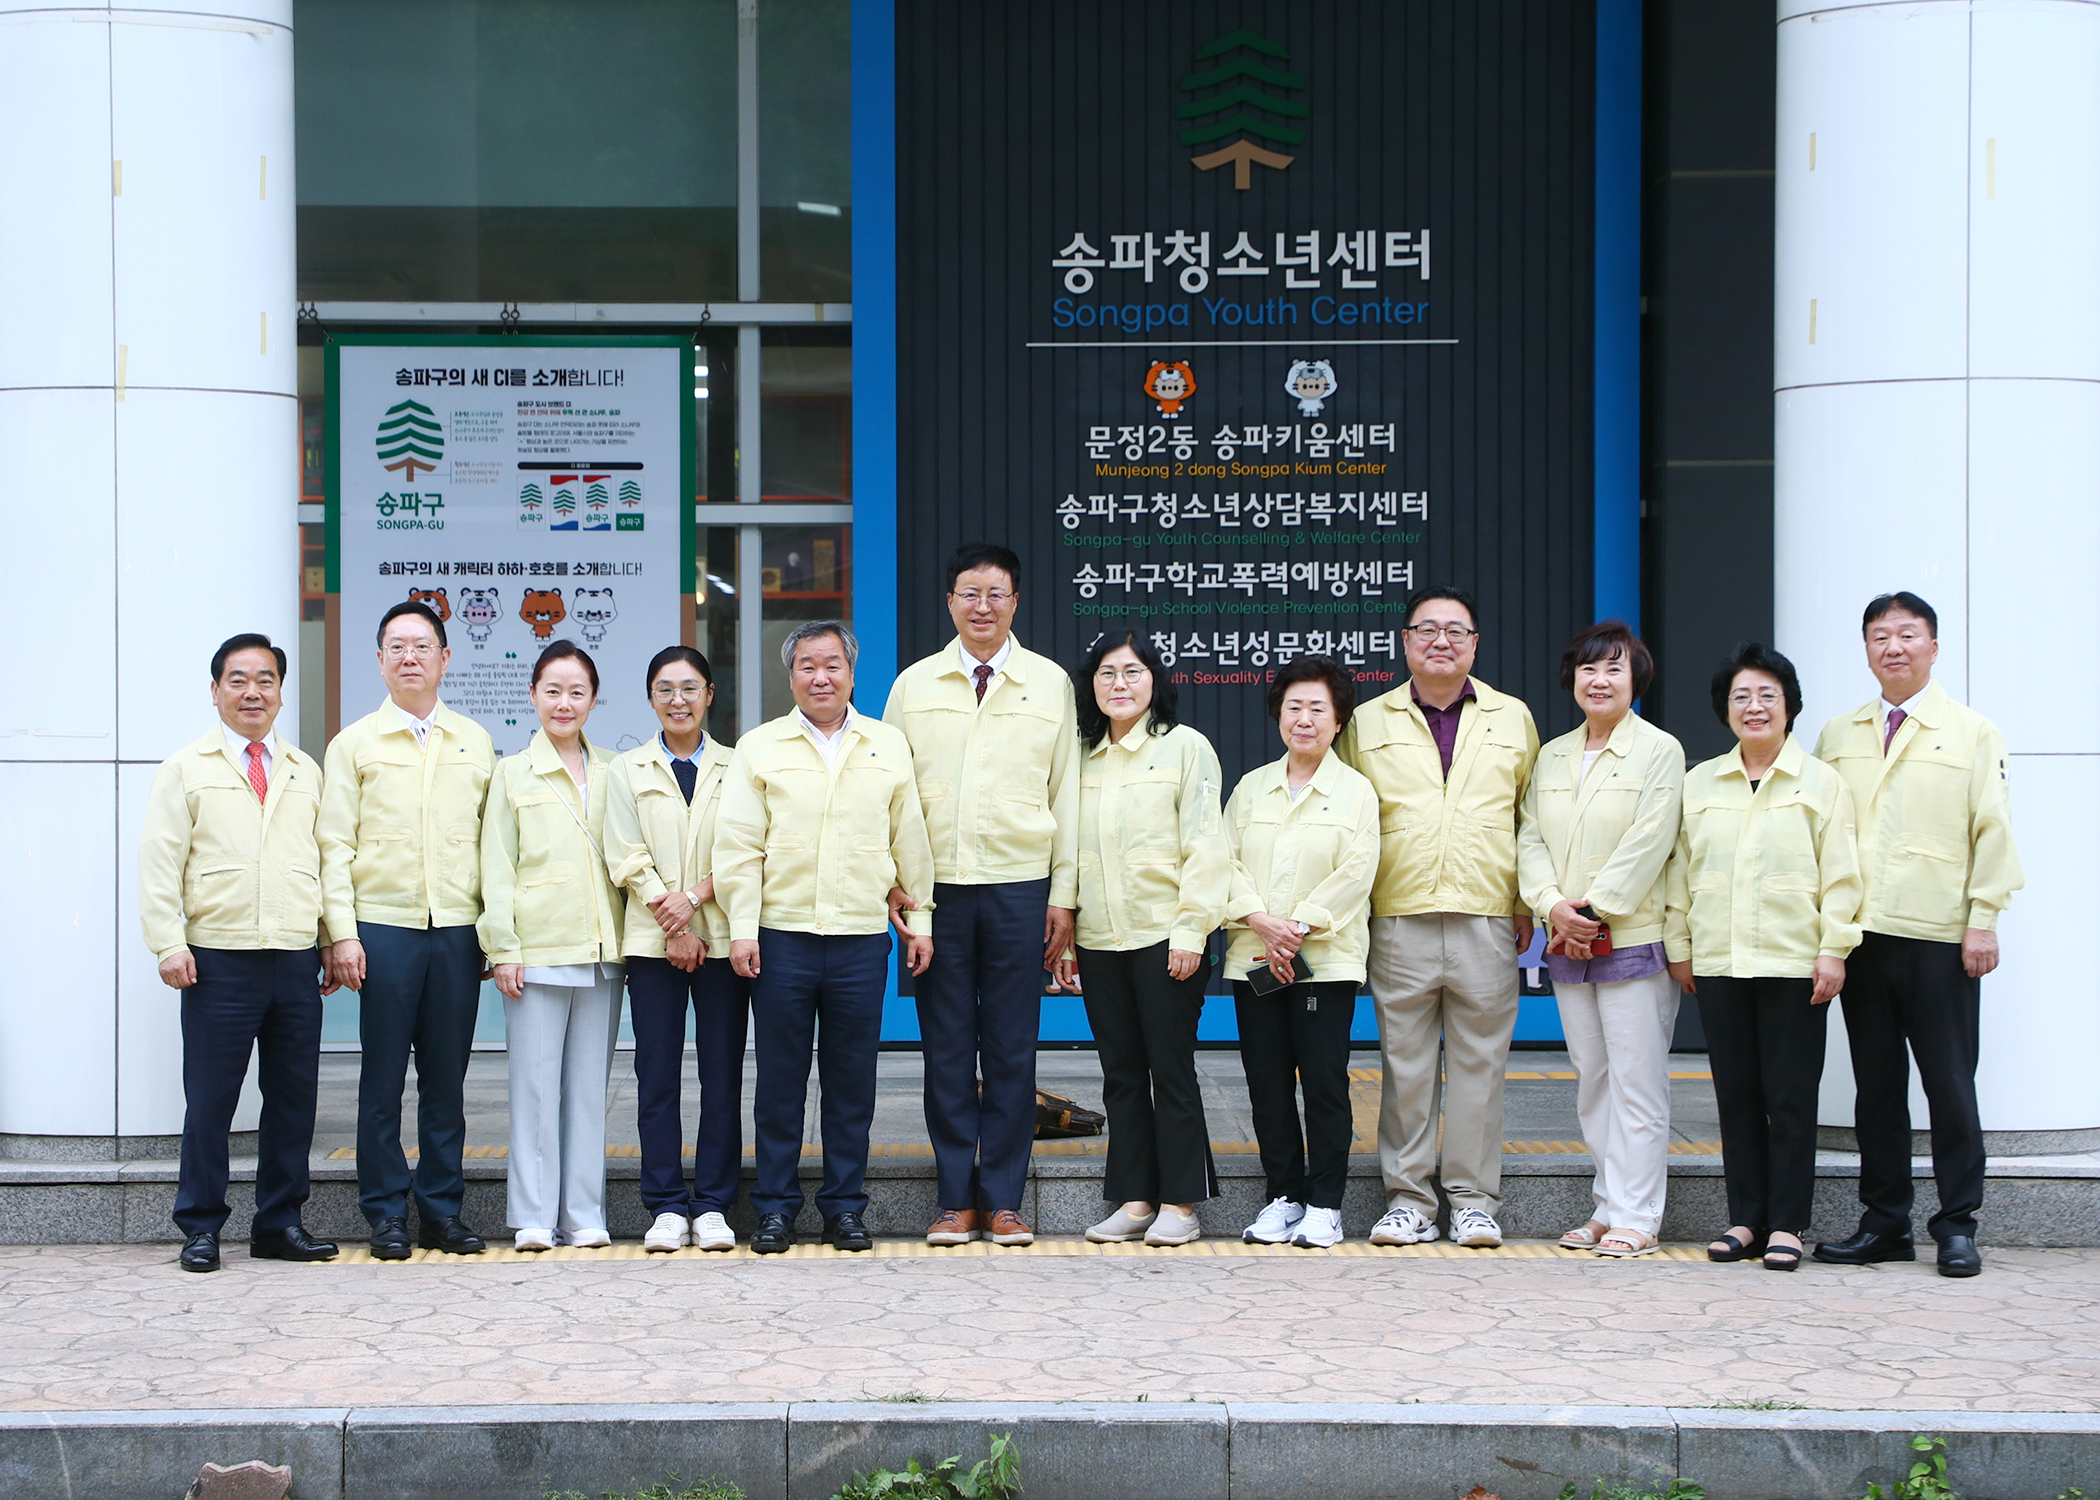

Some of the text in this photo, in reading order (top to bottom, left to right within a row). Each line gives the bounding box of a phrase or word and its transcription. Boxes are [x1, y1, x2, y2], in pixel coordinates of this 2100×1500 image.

[1052, 229, 1430, 294] 송파청소년센터
[1053, 295, 1429, 333] Songpa Youth Center
[395, 368, 466, 387] 송파구의
[471, 368, 489, 387] 새
[532, 368, 625, 387] 소개합니다!
[1085, 422, 1396, 461] 문정2동 송파키움센터
[1095, 461, 1387, 479] Munjeong 2 dong Songpa Kium Center
[375, 492, 445, 517] 송파구
[1055, 491, 1428, 530] 송파구청소년상담복지센터
[376, 519, 445, 530] SONGPA-GU
[519, 513, 544, 523] 송파구
[619, 517, 642, 527] 송파구
[1063, 531, 1421, 549] Songpa-gu Youth Counselling & Welfare Center
[378, 561, 432, 577] 송파구의
[436, 561, 450, 577] 새
[453, 561, 494, 577] 캐릭터
[572, 561, 643, 577] 소개합니다!
[1072, 560, 1414, 599] 송파구학교폭력예방센터
[1072, 600, 1407, 618] Songpa-gu School Violence Prevention Cente
[1086, 629, 1396, 668] 청소년성문화센터
[1192, 670, 1262, 686] Sexuality
